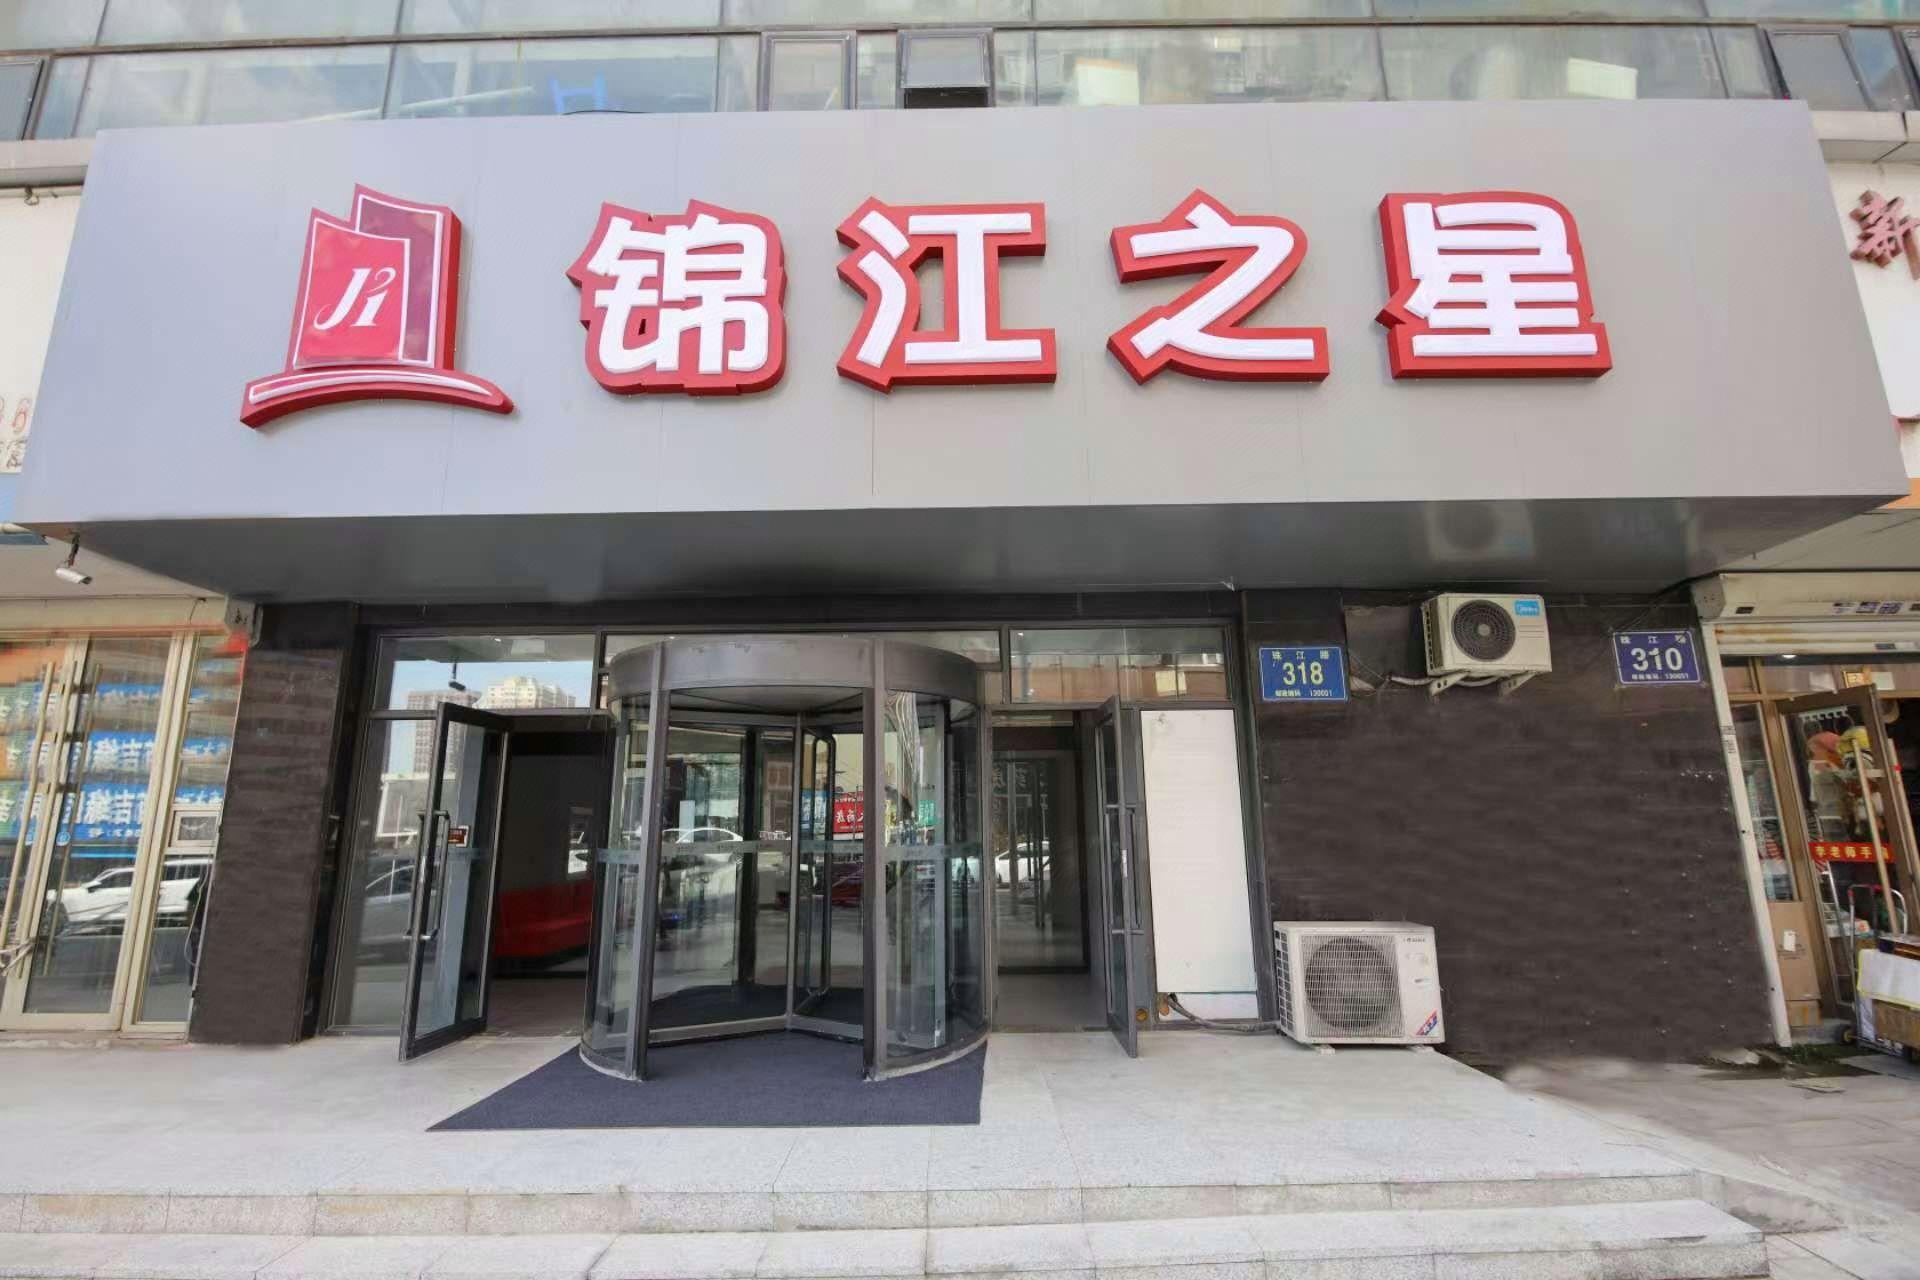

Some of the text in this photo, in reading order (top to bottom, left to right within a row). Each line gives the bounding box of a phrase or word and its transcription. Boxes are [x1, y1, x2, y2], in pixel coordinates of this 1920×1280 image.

[575, 196, 1610, 391] 锦江之星
[1630, 647, 1683, 672] 310
[1283, 661, 1324, 685] 318
